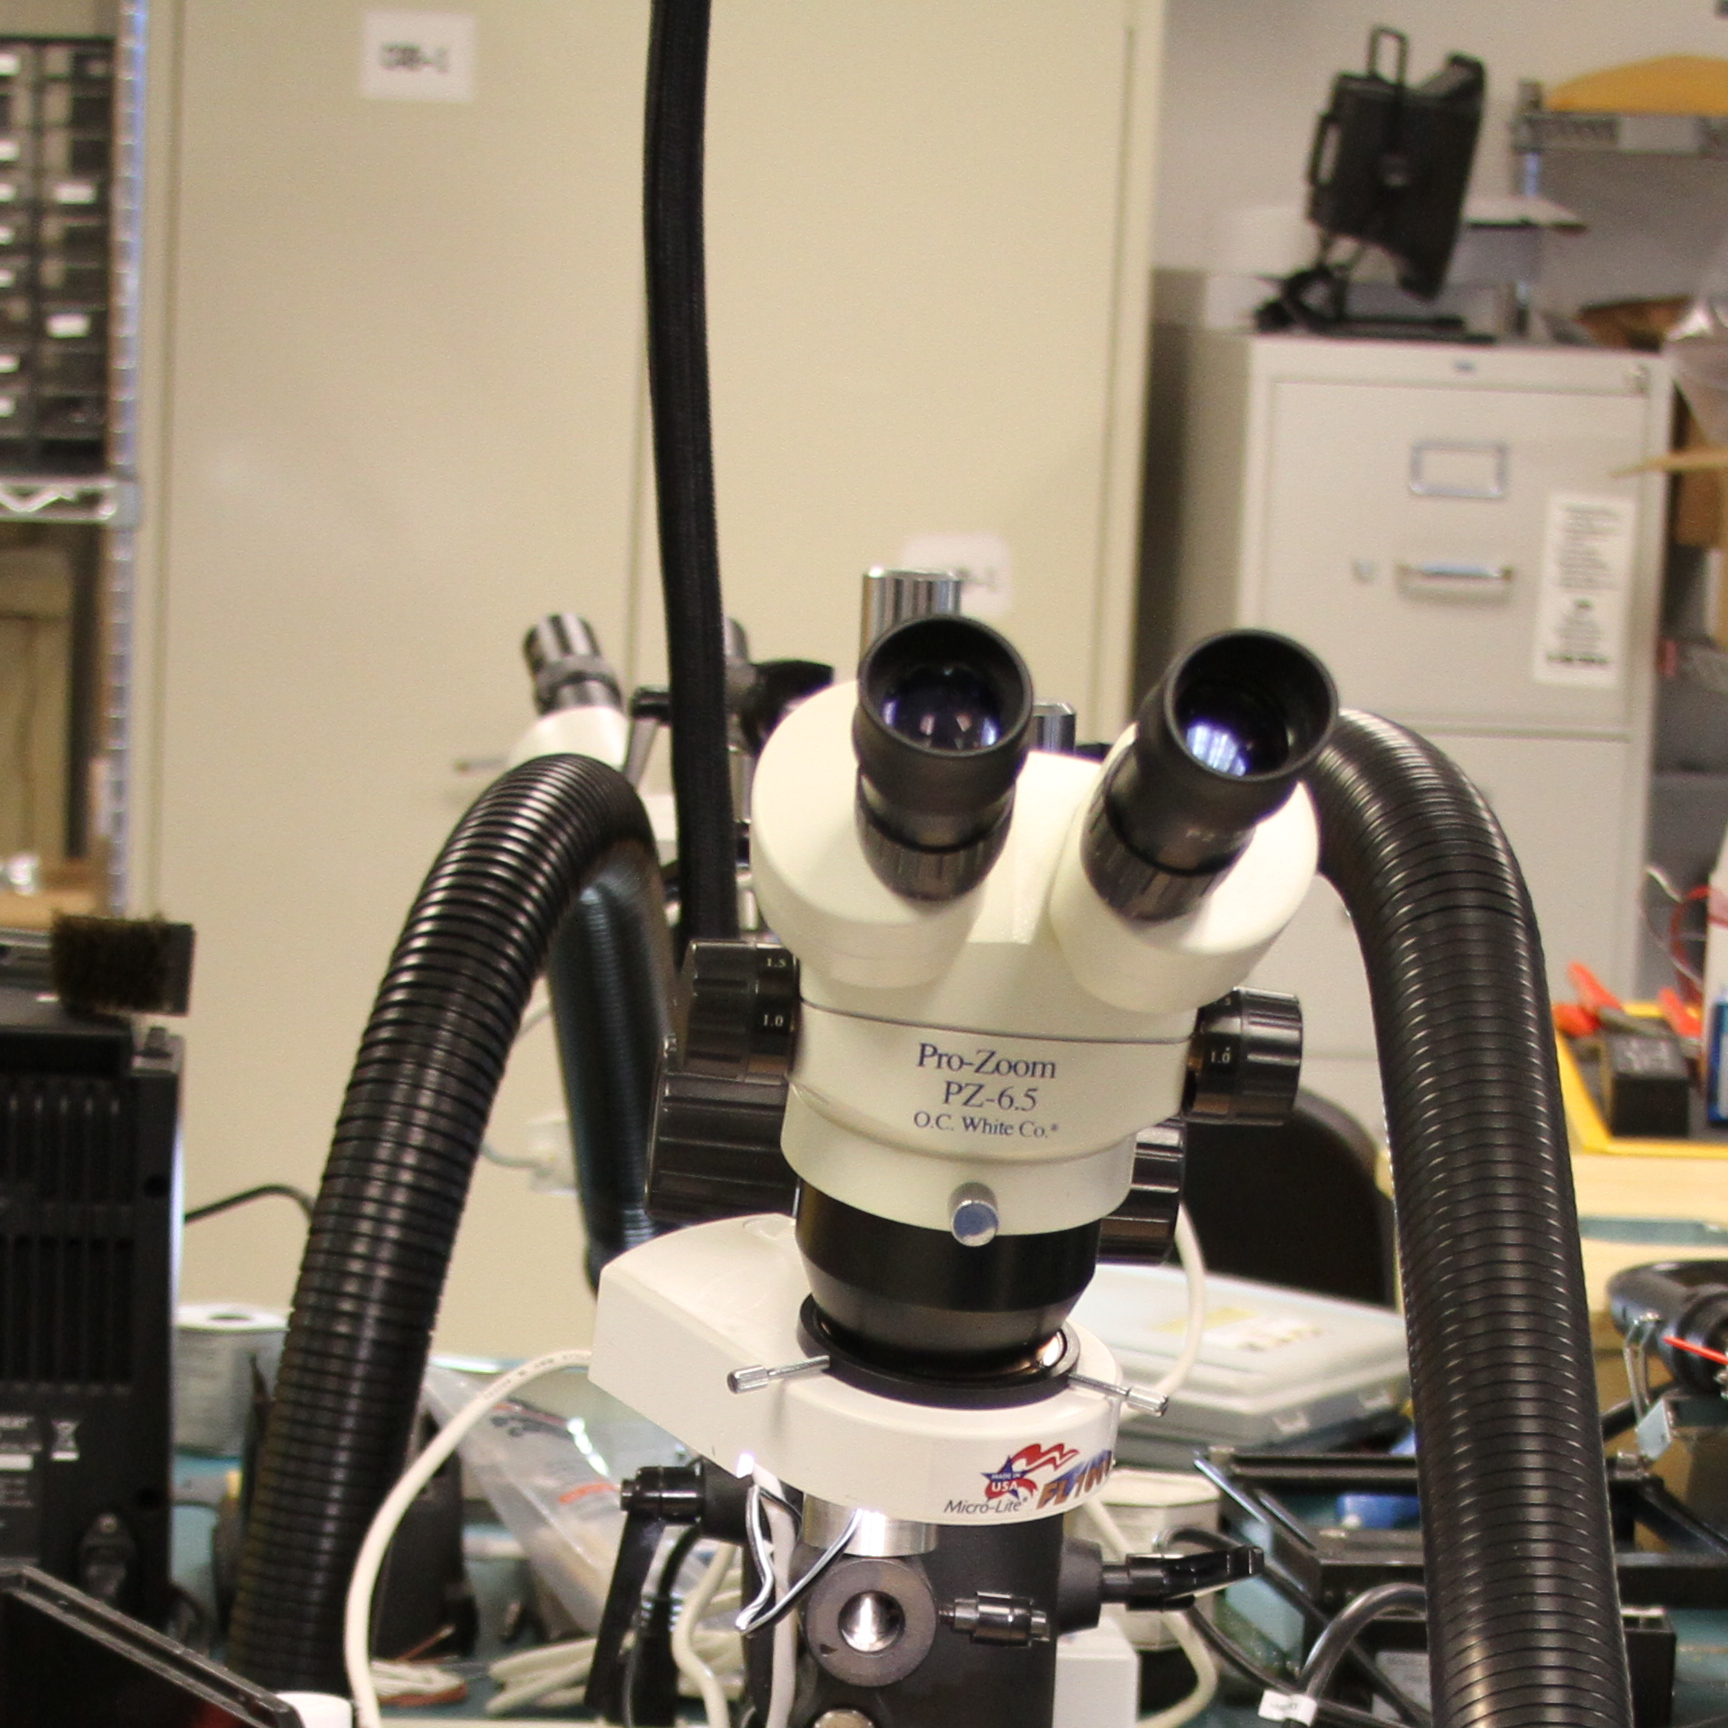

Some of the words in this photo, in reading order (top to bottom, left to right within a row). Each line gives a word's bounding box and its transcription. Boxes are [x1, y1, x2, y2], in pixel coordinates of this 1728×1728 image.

[763, 1013, 784, 1027] 1.0
[916, 1042, 1057, 1079] Pro-Zoom
[942, 1081, 1038, 1112] PZ-6.5
[913, 1111, 954, 1132] O.C.
[962, 1116, 1014, 1137] White
[991, 1481, 1018, 1493] USA
[943, 1499, 1022, 1515] Micro-Lite
